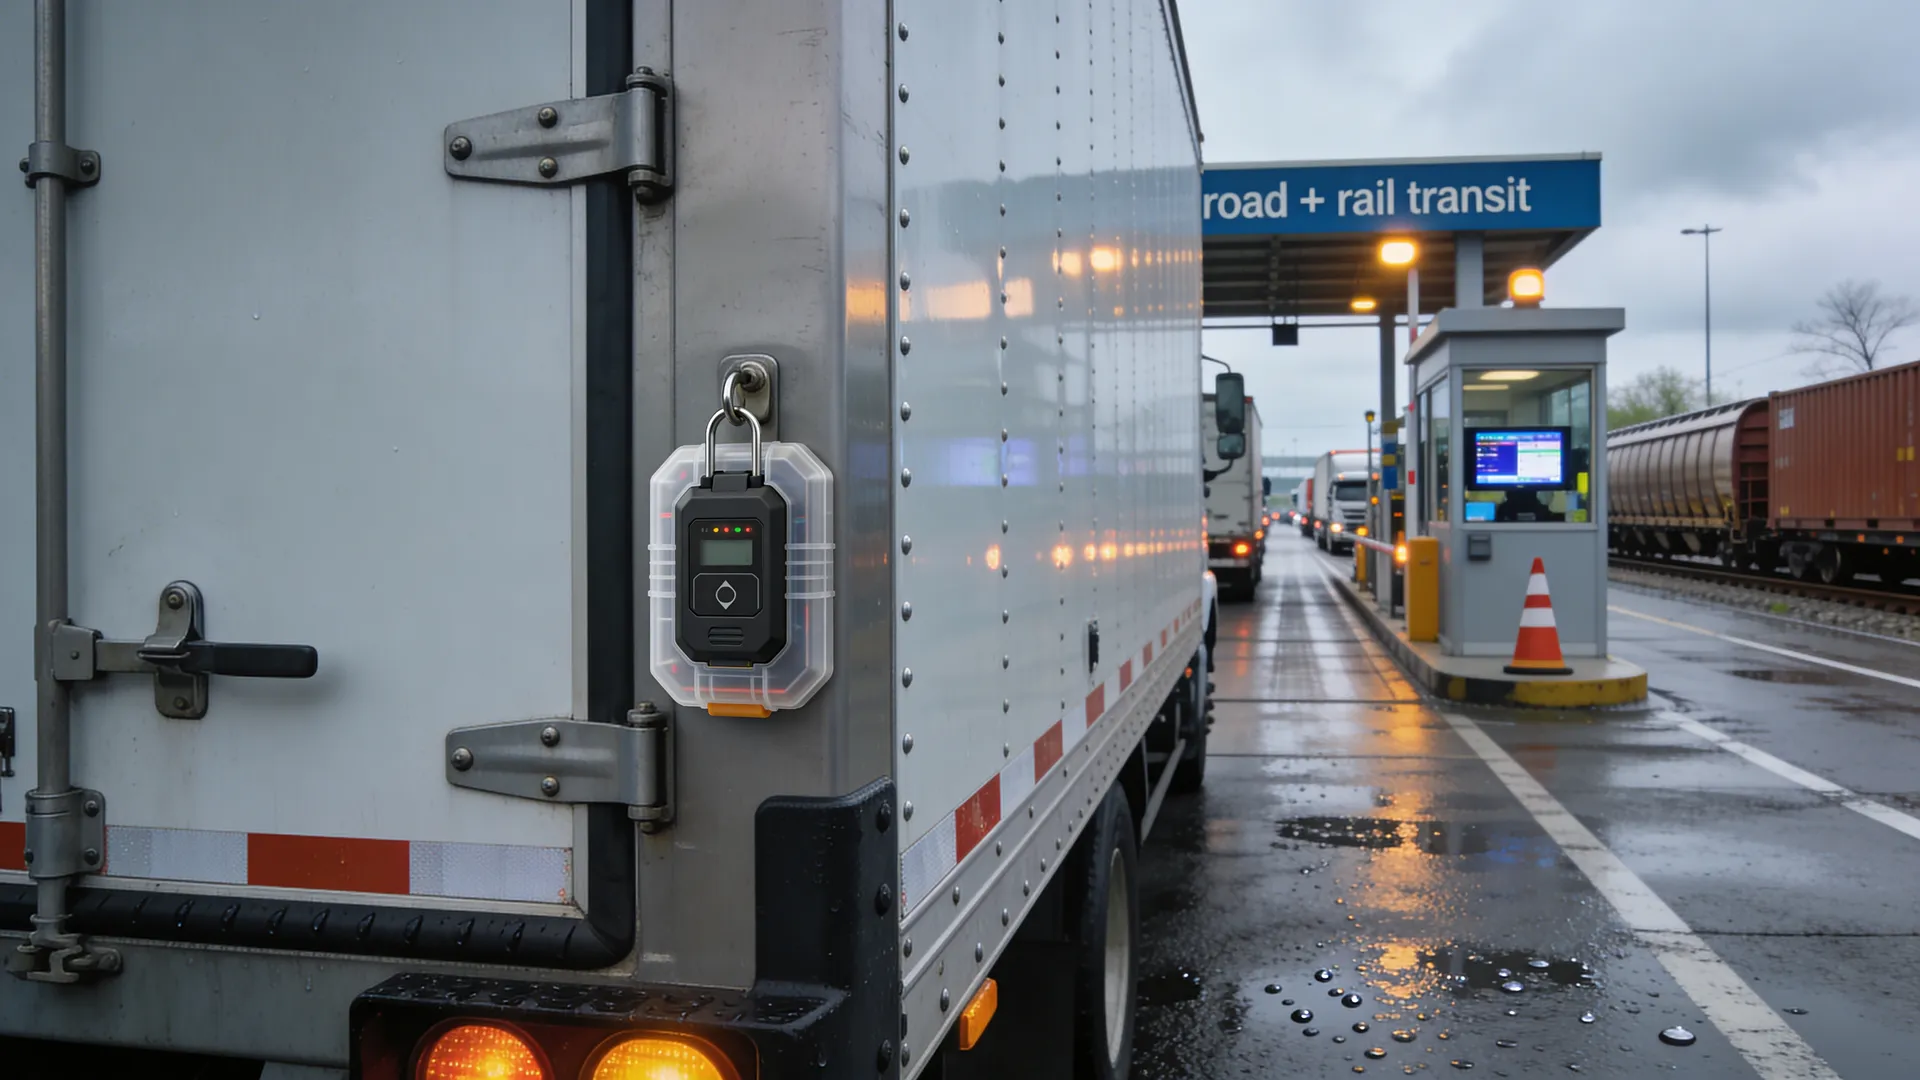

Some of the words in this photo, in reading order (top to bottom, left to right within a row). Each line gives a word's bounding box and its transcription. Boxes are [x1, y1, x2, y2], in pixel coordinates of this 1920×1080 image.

[1203, 181, 1288, 219] road
[1300, 187, 1325, 213] +
[1338, 178, 1395, 217] rail
[1407, 176, 1532, 215] transit
